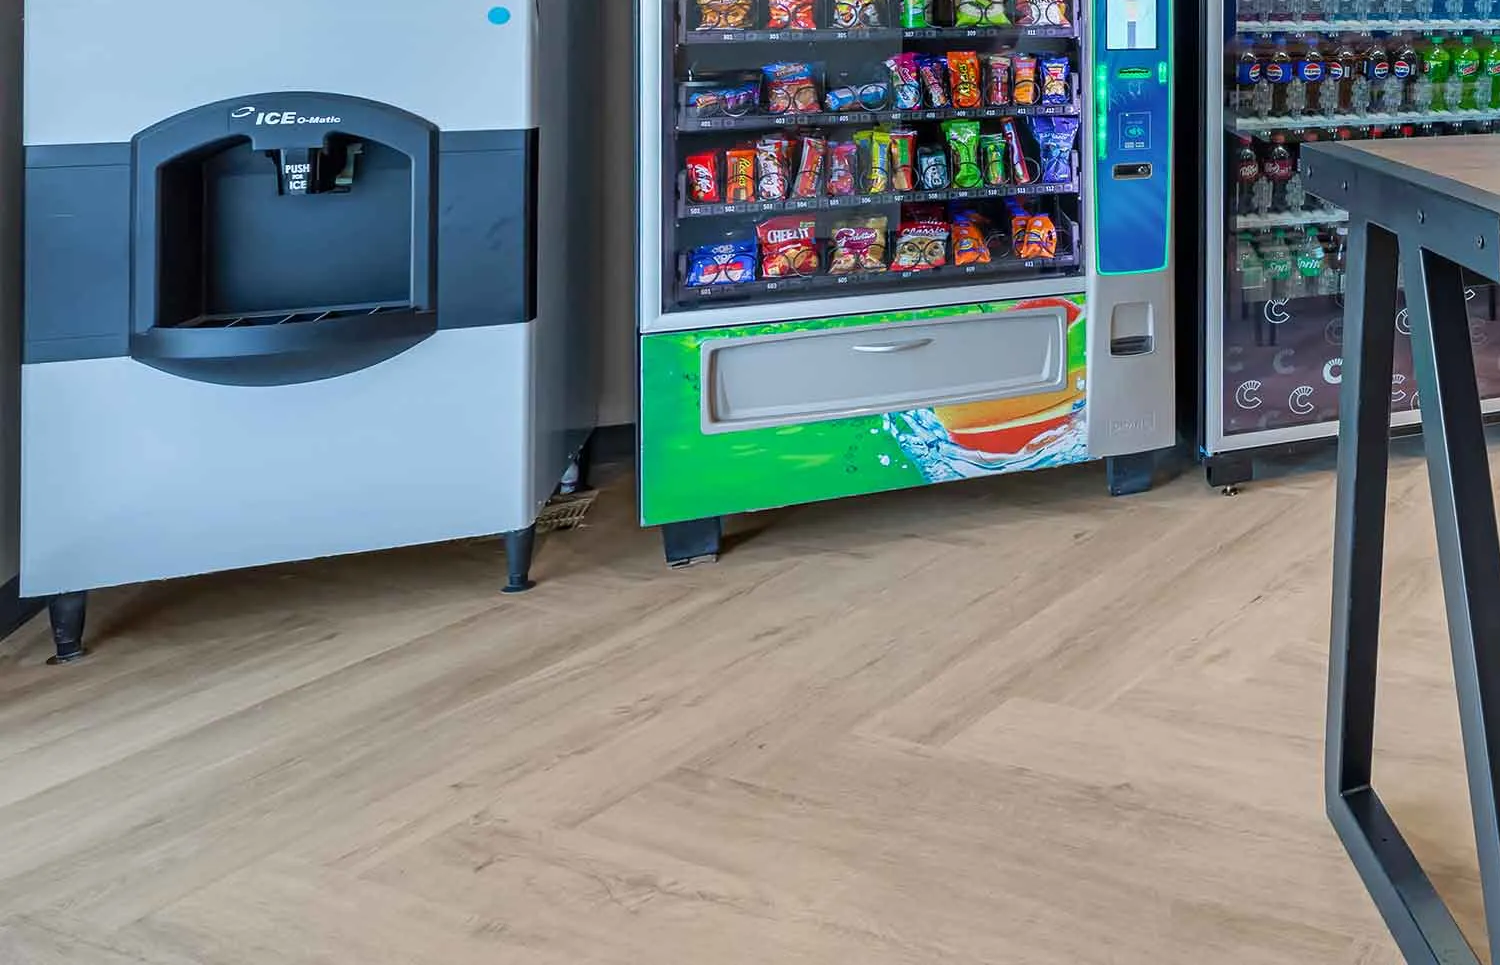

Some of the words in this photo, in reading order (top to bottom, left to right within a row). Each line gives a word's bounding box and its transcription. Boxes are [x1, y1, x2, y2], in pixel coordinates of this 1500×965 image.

[256, 112, 297, 125] ICE
[297, 116, 341, 124] O-Matic
[285, 164, 310, 174] PUSH
[289, 181, 307, 190] ICE
